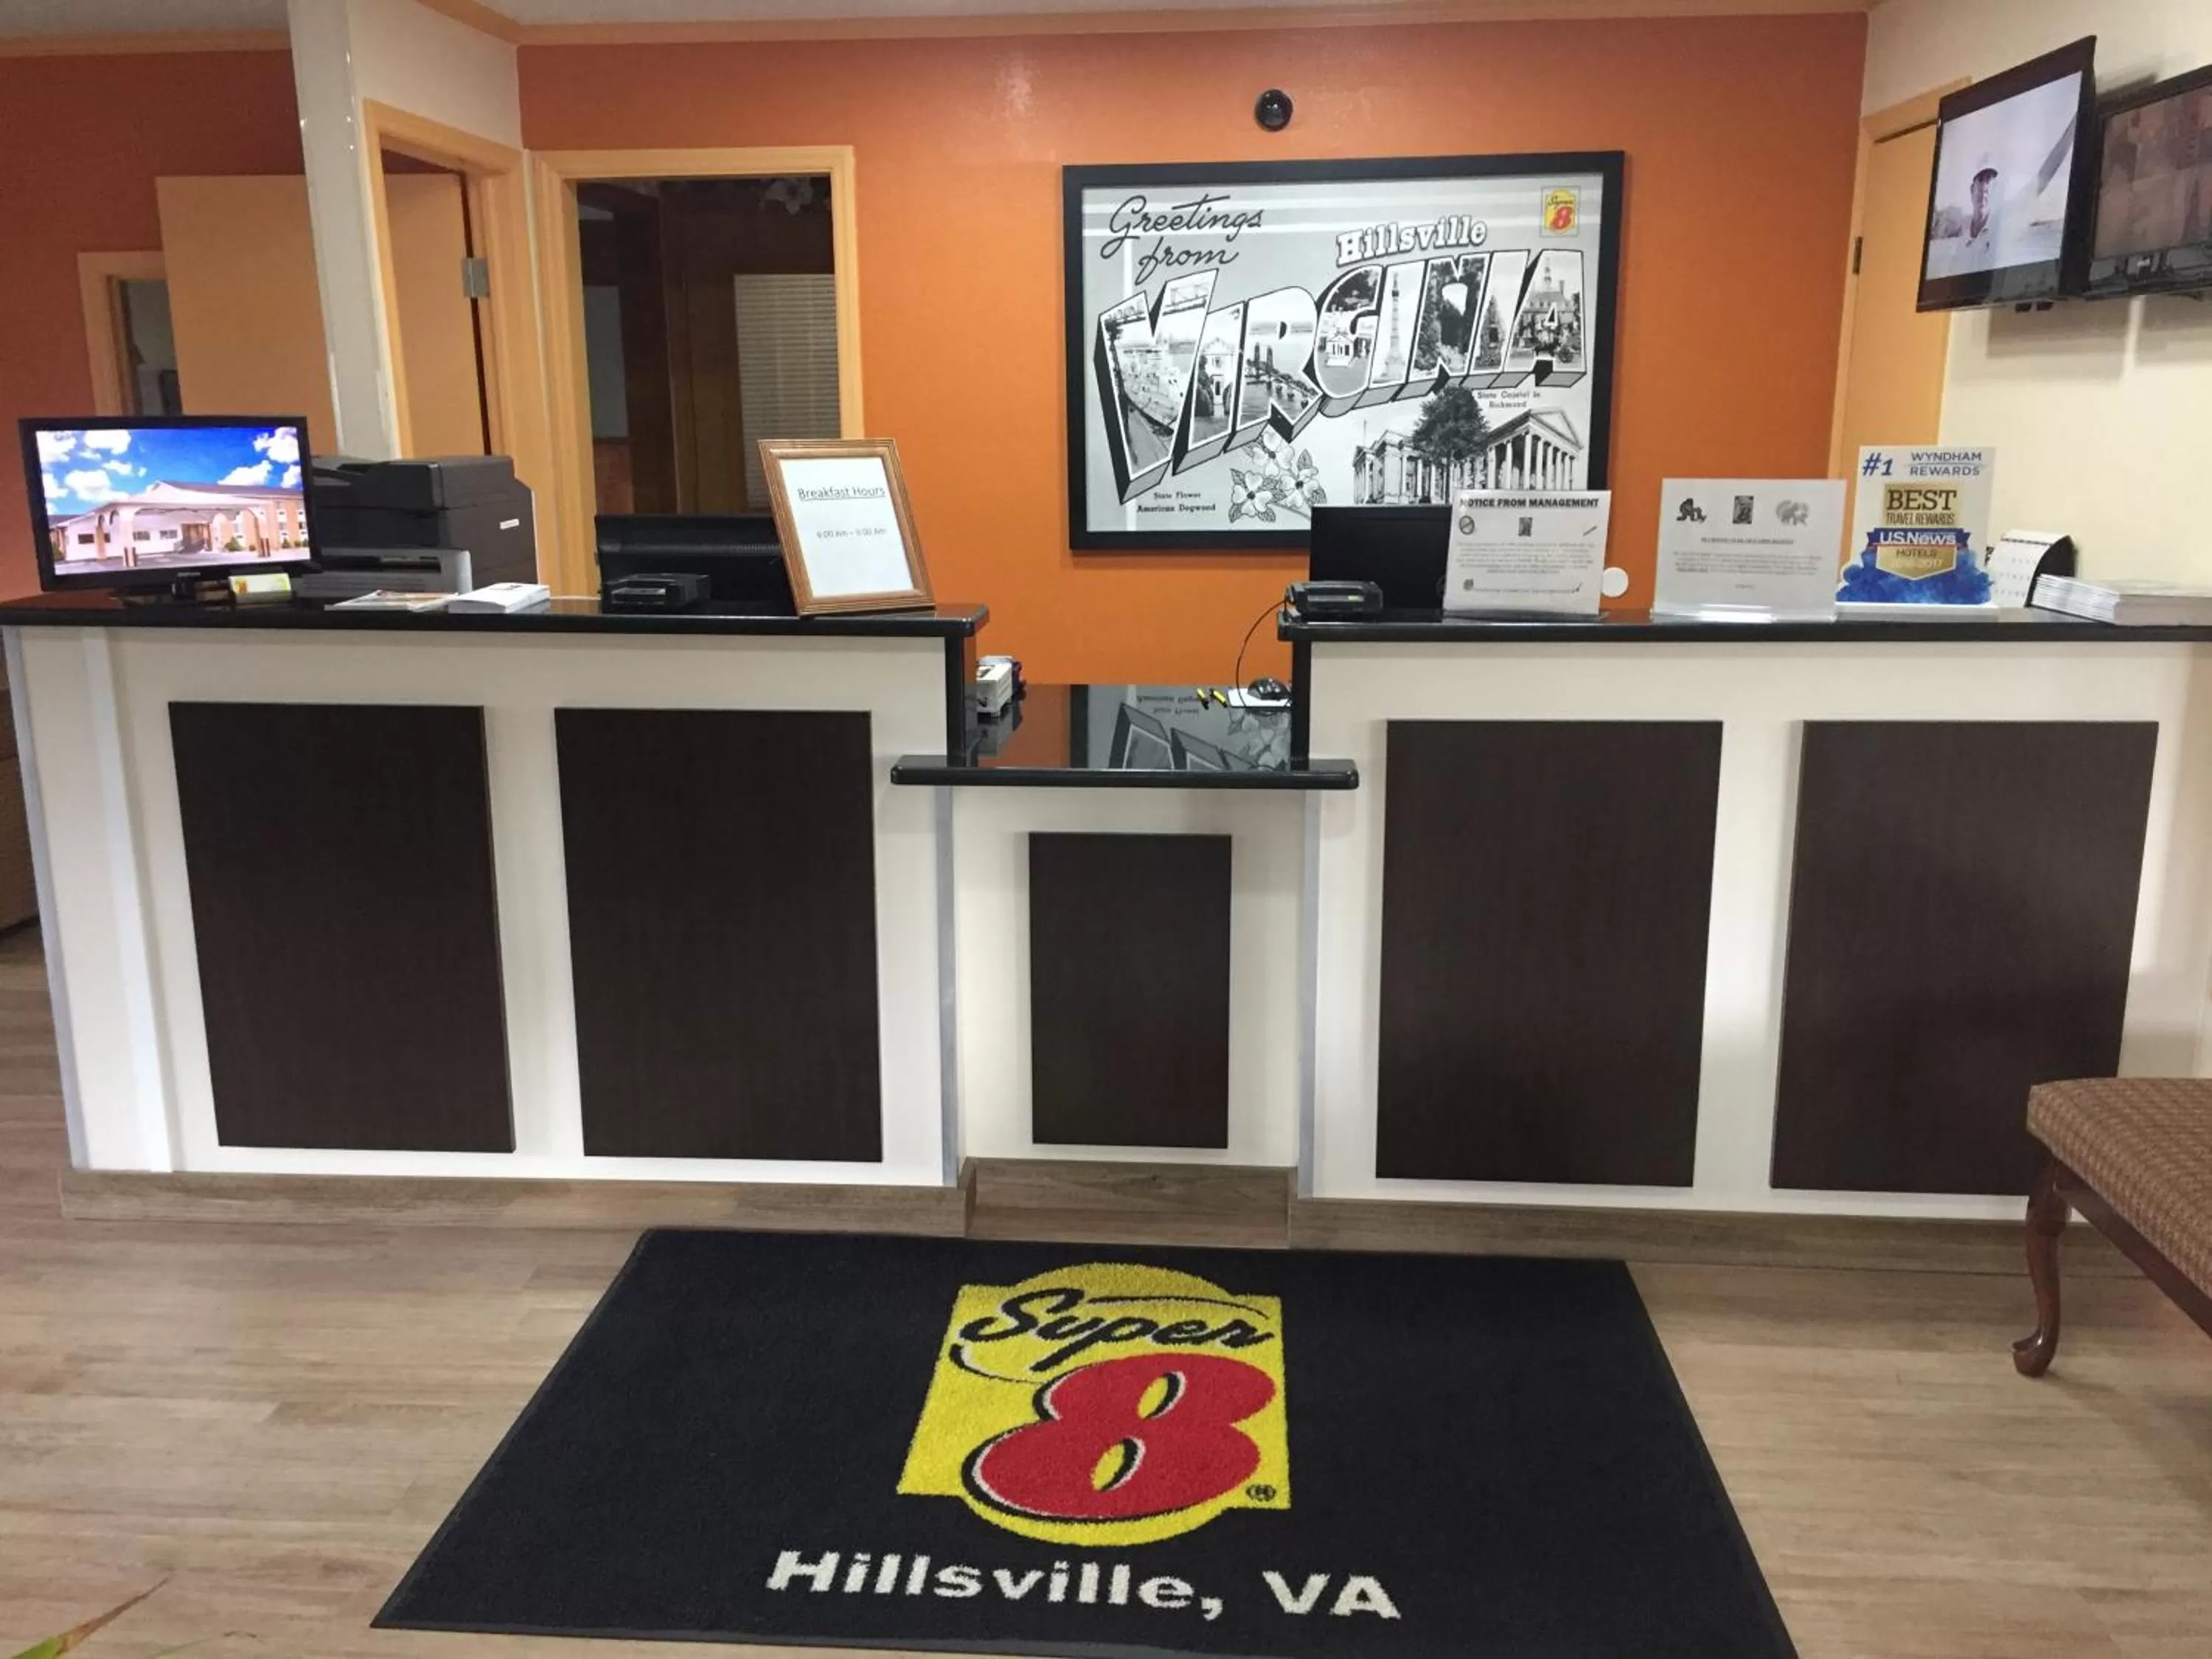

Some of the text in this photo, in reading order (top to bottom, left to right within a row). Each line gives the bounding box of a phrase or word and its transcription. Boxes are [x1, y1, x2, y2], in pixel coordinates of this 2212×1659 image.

[1100, 193, 1265, 260] Greetings
[1336, 215, 1487, 268] Hillsville
[1138, 236, 1239, 286] from
[1093, 249, 1587, 506] VIRGINIA
[1863, 452, 1982, 476] #1 WYNDHAM
[1910, 465, 1980, 476] REWARDS
[797, 485, 886, 500] Breakfast Hours
[1459, 498, 1599, 509] NOTICE FROM MANAGEMENT
[1886, 489, 1958, 511] BEST
[1886, 512, 1955, 525] TRAVEL REWARDS
[960, 1287, 1274, 1373] Super
[961, 1352, 1277, 1523] 8
[767, 1551, 1402, 1621] Hillsville, VA
